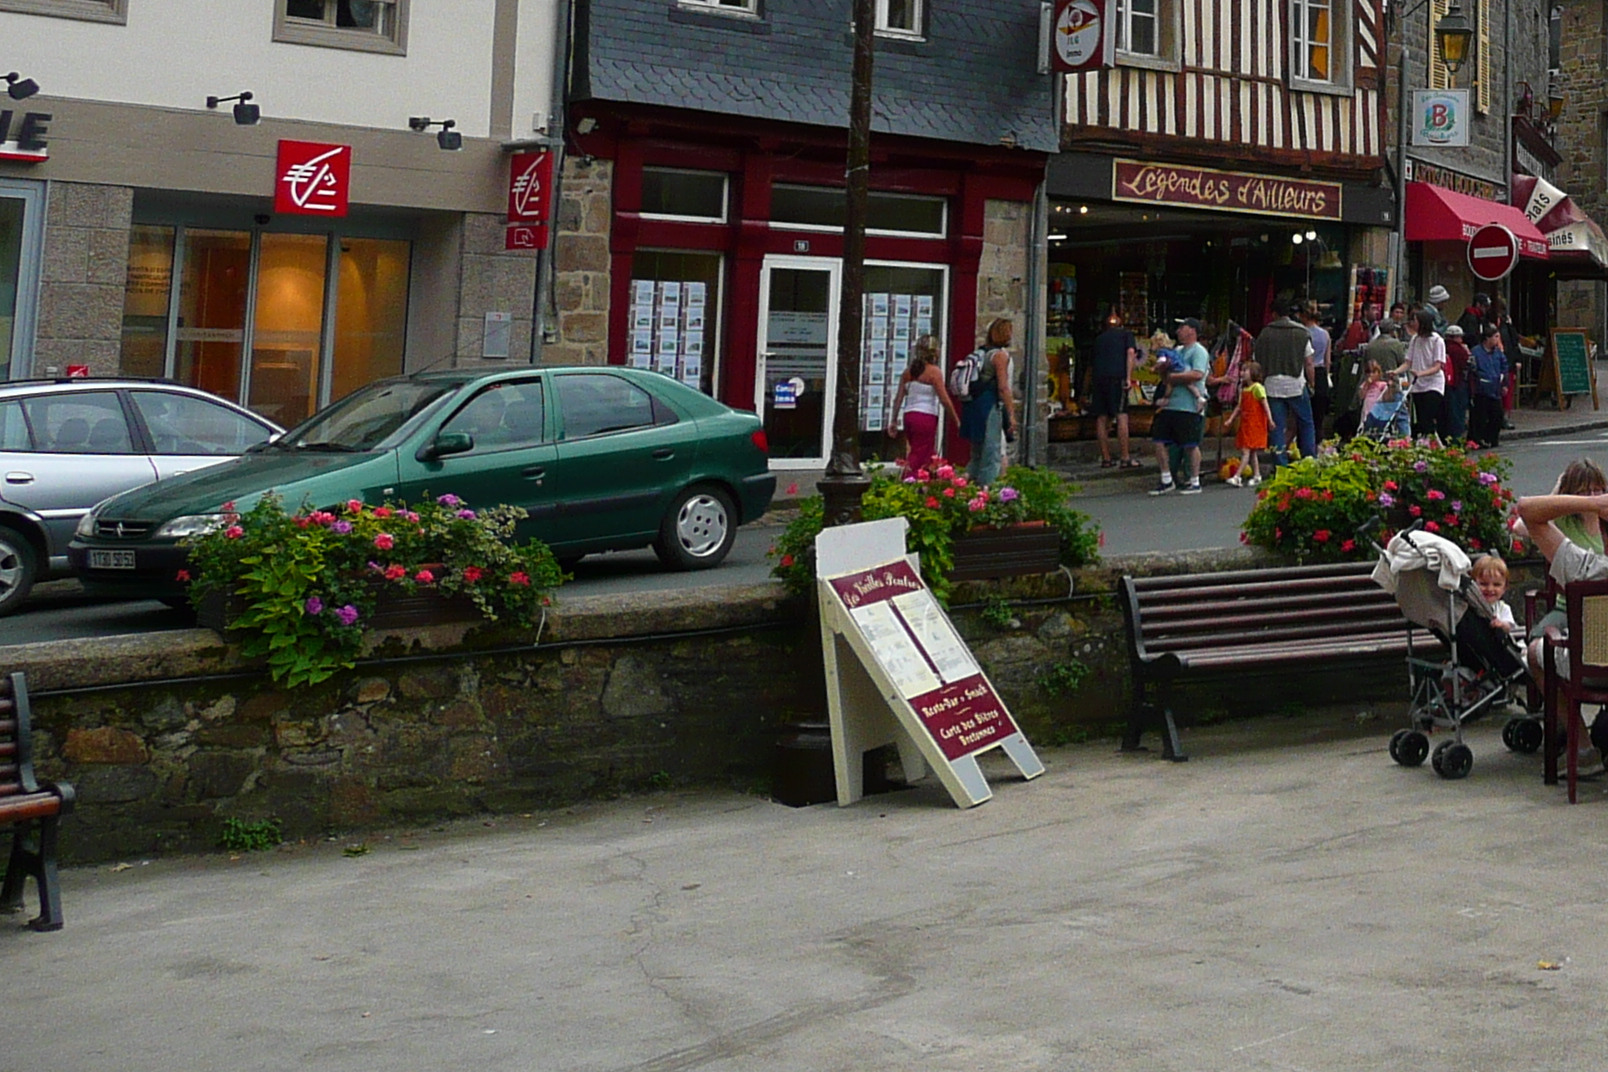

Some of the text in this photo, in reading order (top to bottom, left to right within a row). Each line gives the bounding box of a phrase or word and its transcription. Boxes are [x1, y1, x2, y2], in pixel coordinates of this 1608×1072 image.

[1432, 103, 1448, 127] B
[1122, 166, 1326, 214] Légendes d'Ailleurs
[921, 683, 988, 718] Resto-Bar Snack
[940, 724, 962, 739] Carte
[974, 709, 999, 724] Bières
[958, 725, 996, 746] Bretonnes
